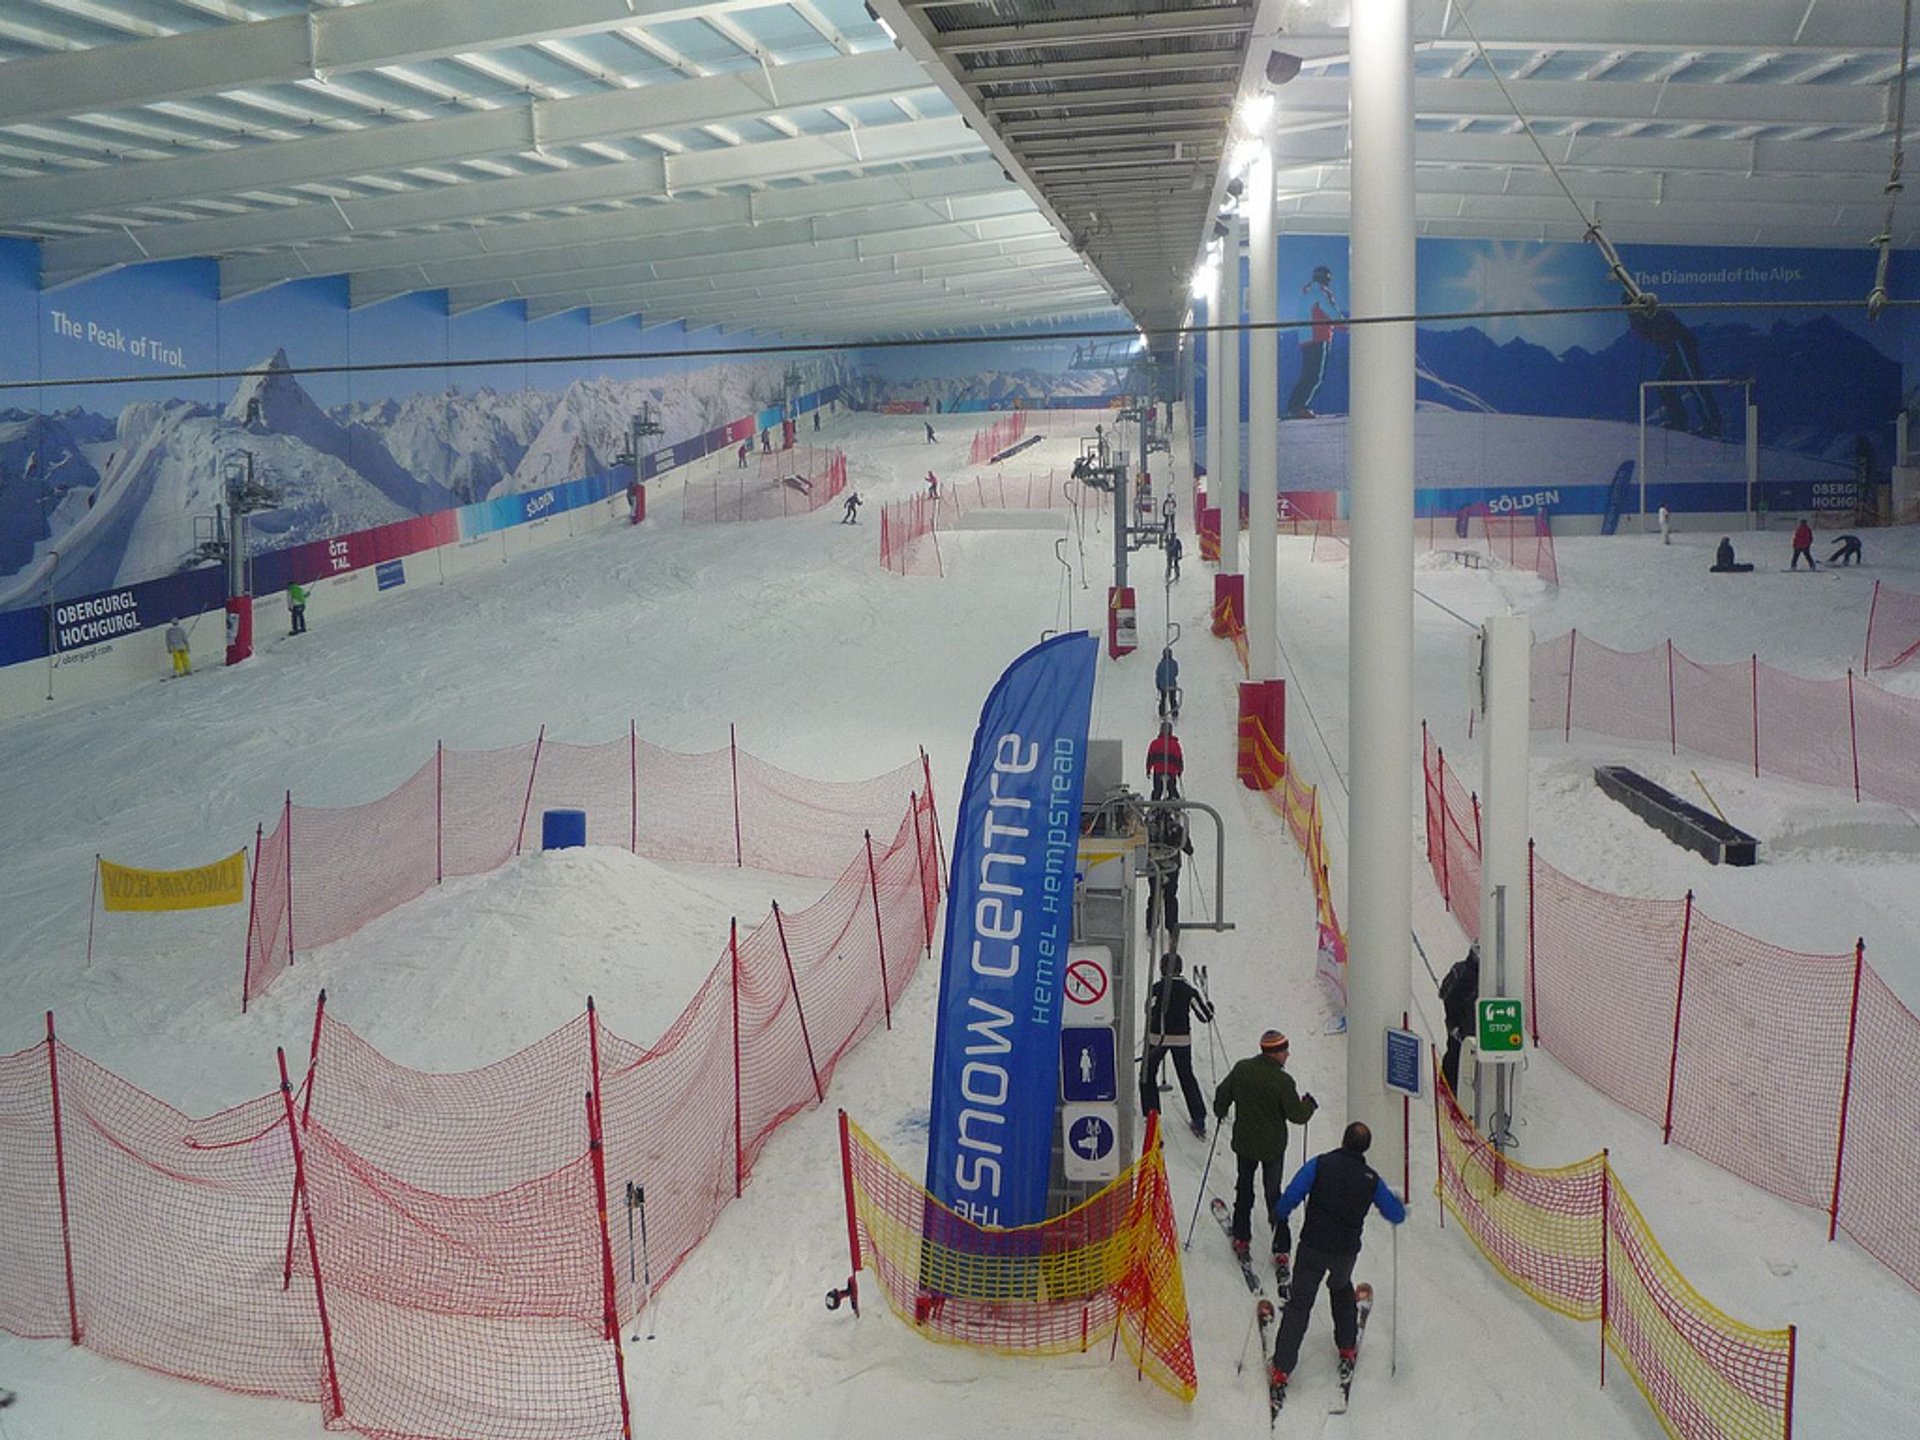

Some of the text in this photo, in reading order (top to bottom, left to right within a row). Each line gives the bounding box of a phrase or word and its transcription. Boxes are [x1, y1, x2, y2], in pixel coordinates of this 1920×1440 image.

[1634, 271, 1659, 285] The
[1661, 268, 1726, 285] Diamond
[1728, 267, 1743, 283] of
[1745, 266, 1768, 282] the
[51, 310, 186, 369] The Peak of Tirol.
[1489, 489, 1560, 513] SÖLDEN
[331, 556, 351, 571] TAL
[56, 591, 138, 626] OBERGURGL
[60, 611, 142, 647] HOCHGURGL
[1489, 1023, 1513, 1033] STOP
